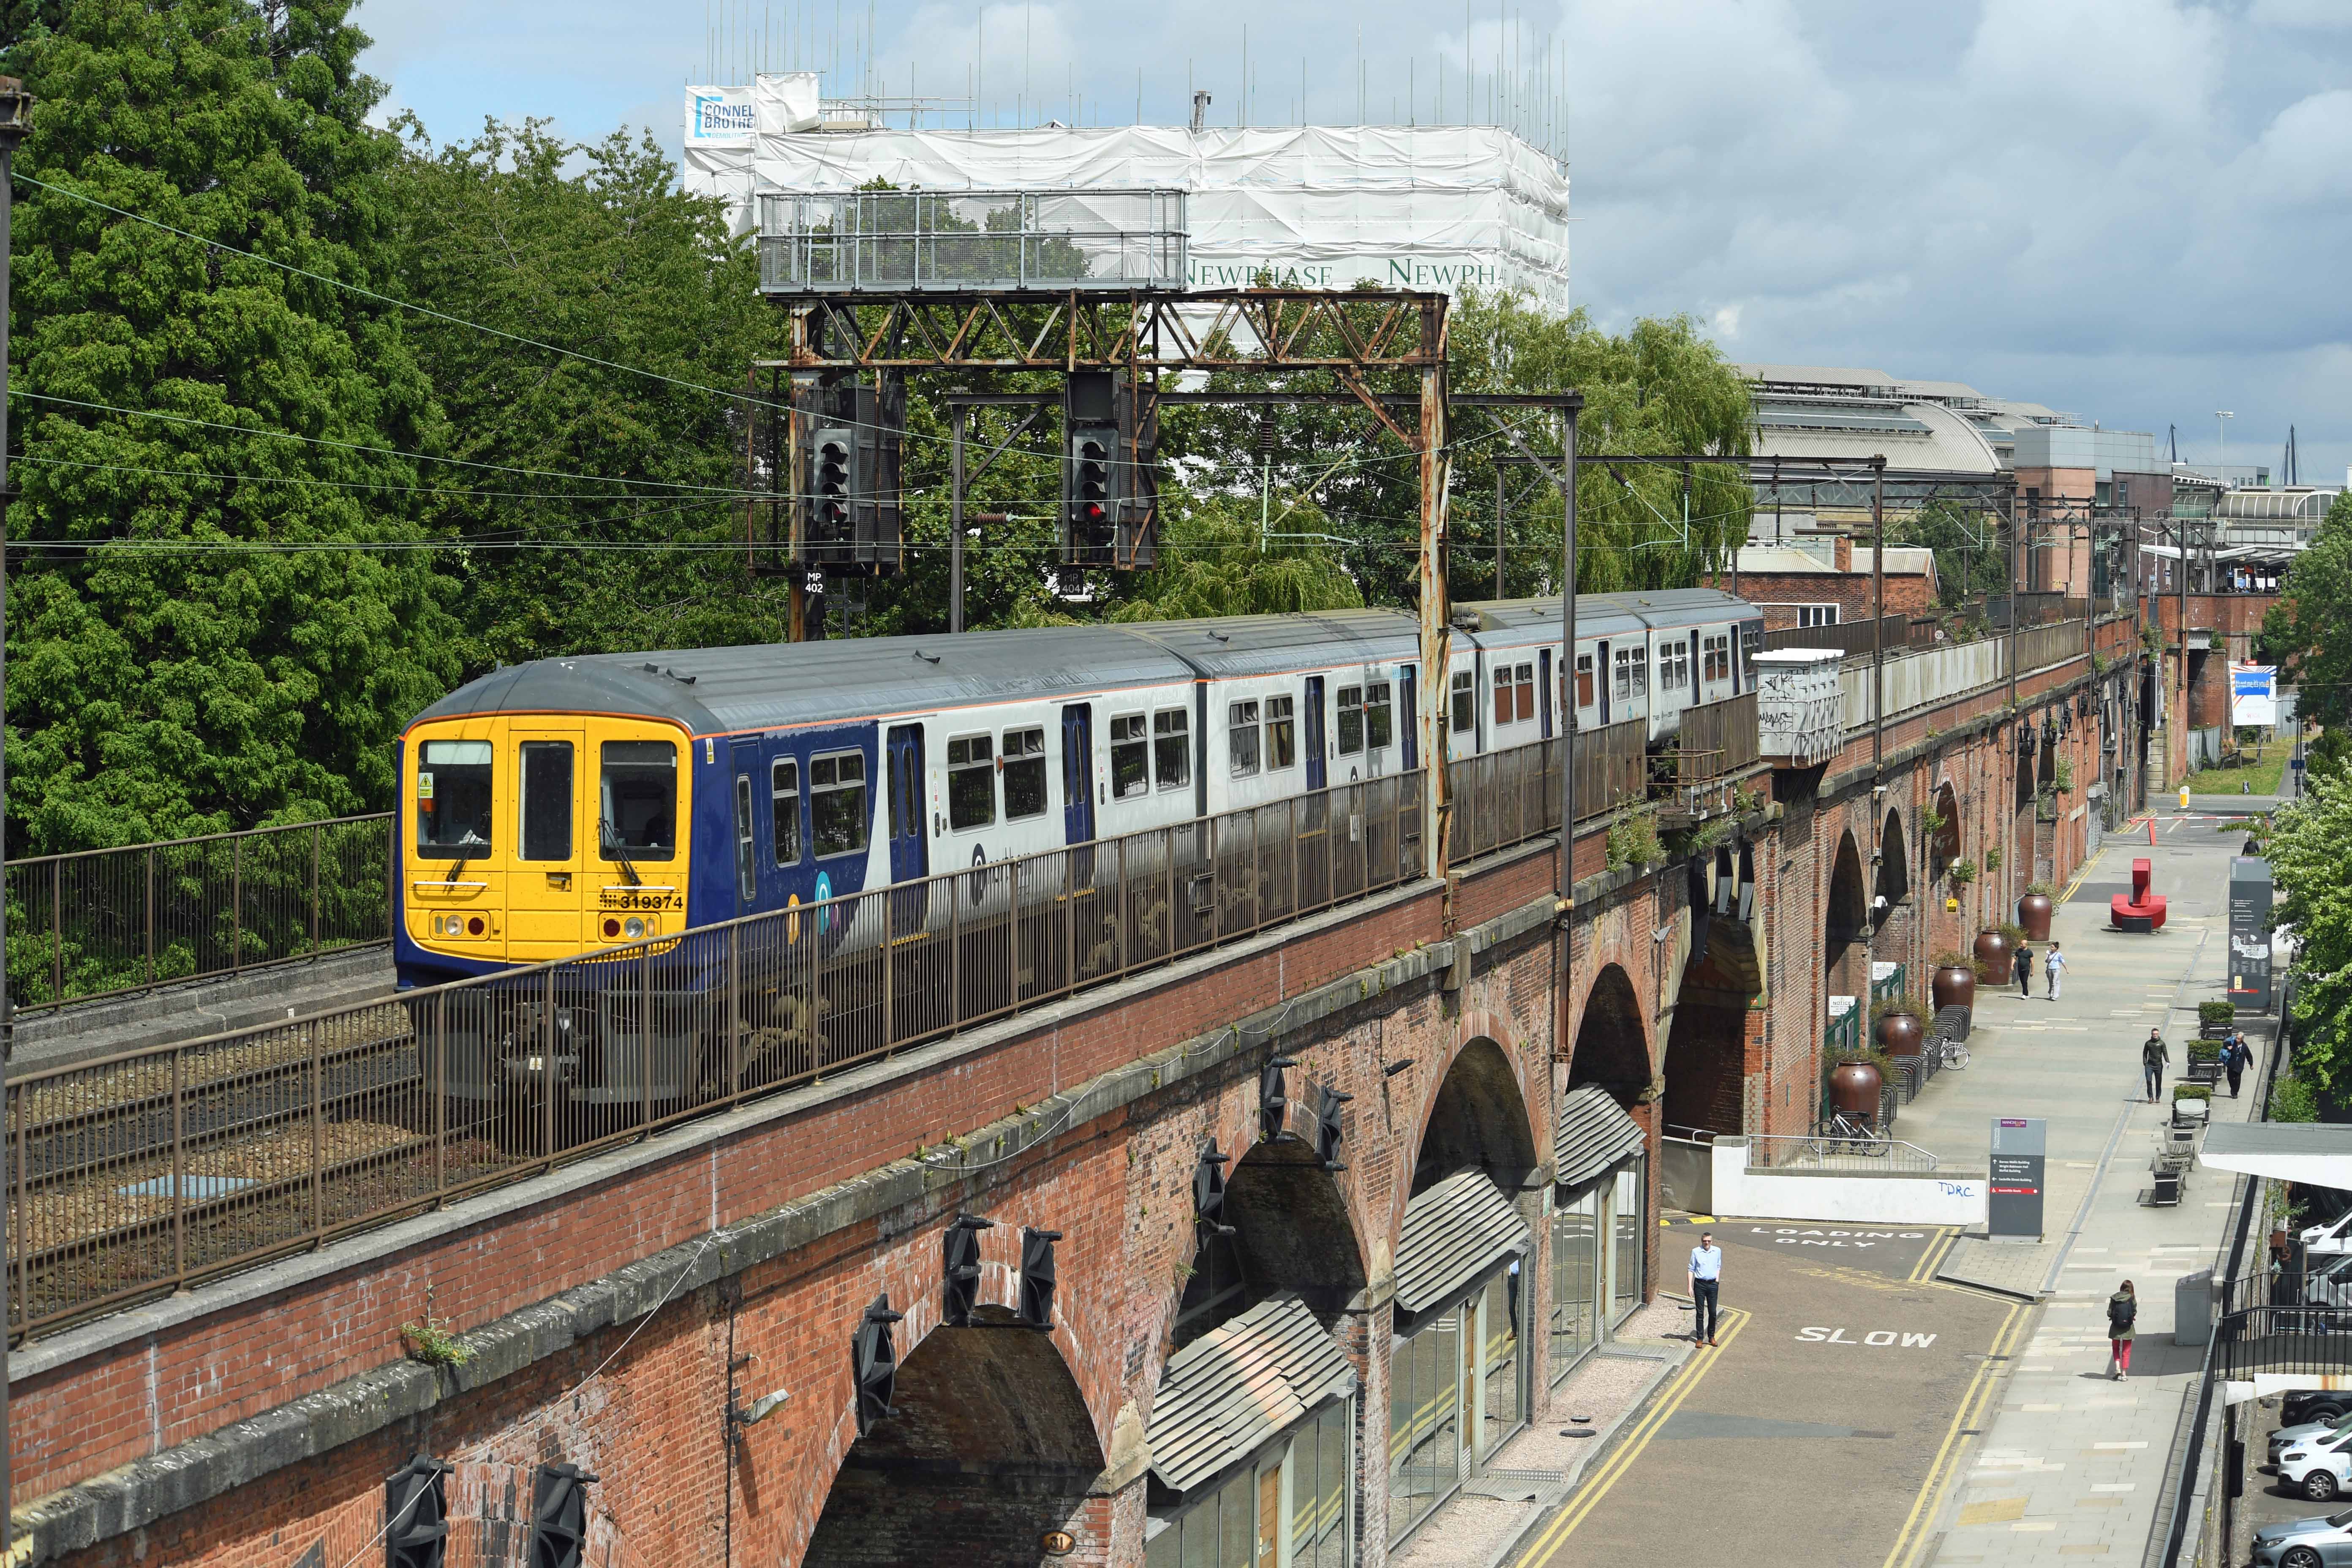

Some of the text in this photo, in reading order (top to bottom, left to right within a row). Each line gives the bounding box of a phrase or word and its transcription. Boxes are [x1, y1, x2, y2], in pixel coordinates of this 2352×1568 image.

[705, 105, 754, 117] CONNEL
[705, 117, 754, 128] BROTHE
[808, 572, 821, 581] MP
[1064, 574, 1078, 582] MP
[805, 583, 823, 593] 402
[1062, 584, 1081, 593] 404
[621, 896, 683, 909] 319374
[1938, 1181, 1975, 1197] TDRC
[1750, 1227, 1924, 1238] LOADING
[1775, 1239, 1876, 1247] ONLY
[1794, 1327, 1937, 1348] SLOW
